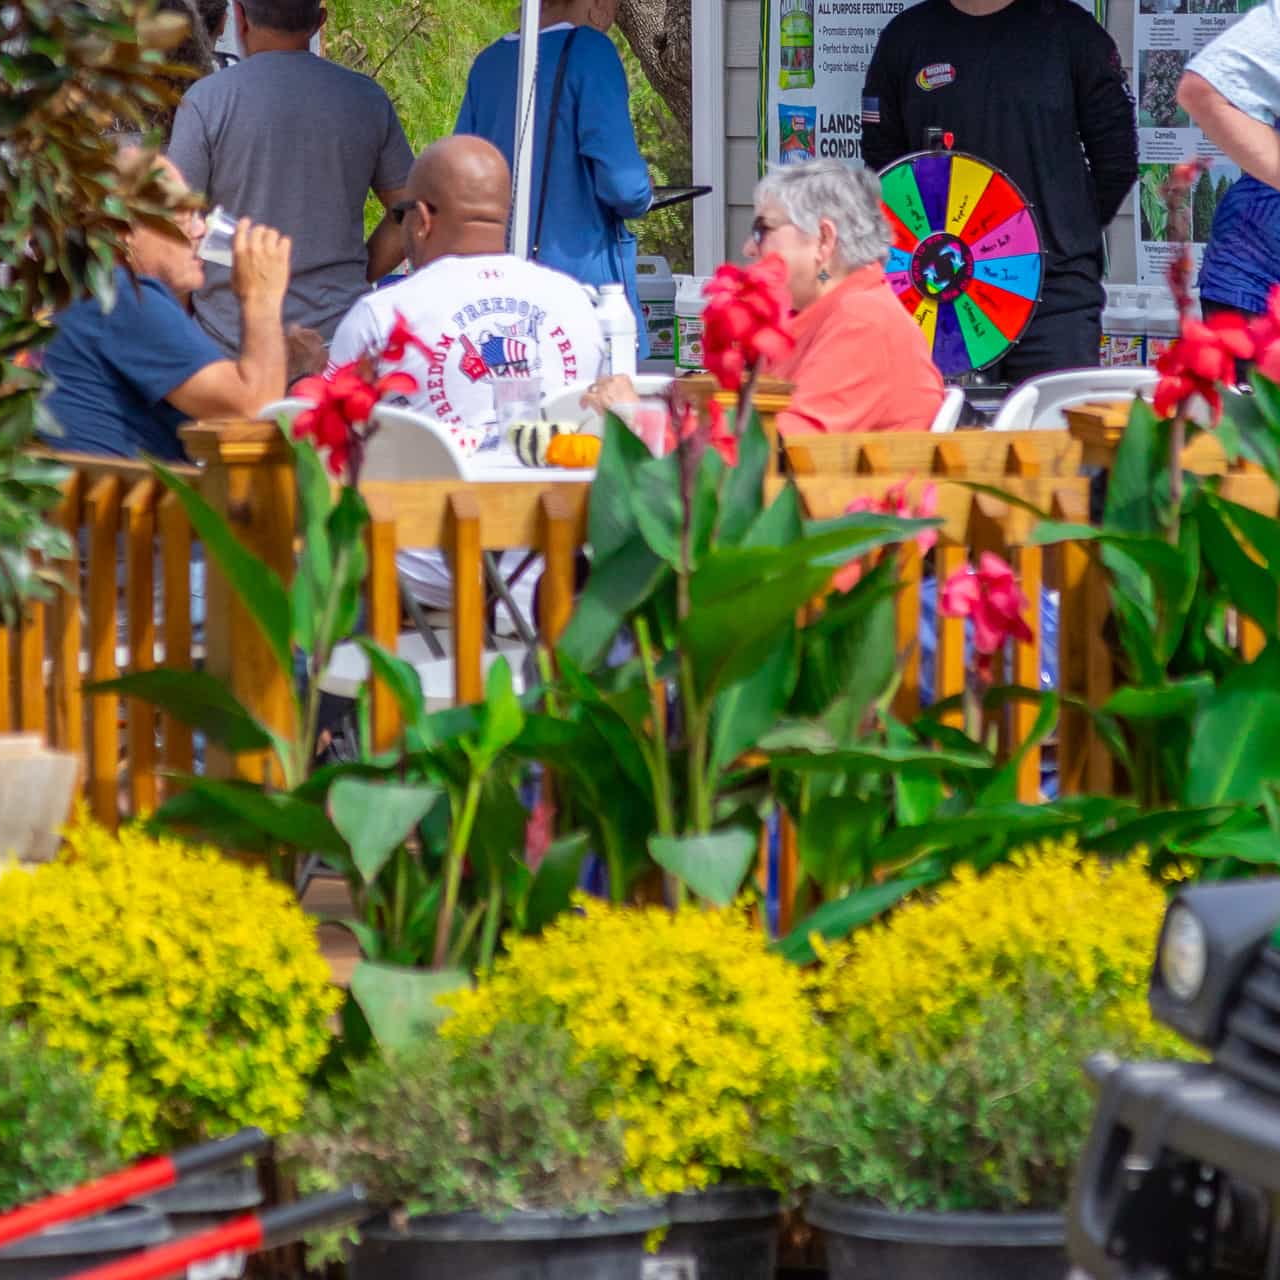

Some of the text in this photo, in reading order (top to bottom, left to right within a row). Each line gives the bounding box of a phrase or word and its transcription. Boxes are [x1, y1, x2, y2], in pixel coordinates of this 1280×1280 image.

[818, 3, 831, 15] ALL
[832, 3, 861, 15] PURPOSE
[820, 113, 862, 134] LANDS
[452, 296, 547, 329] FREEDOM
